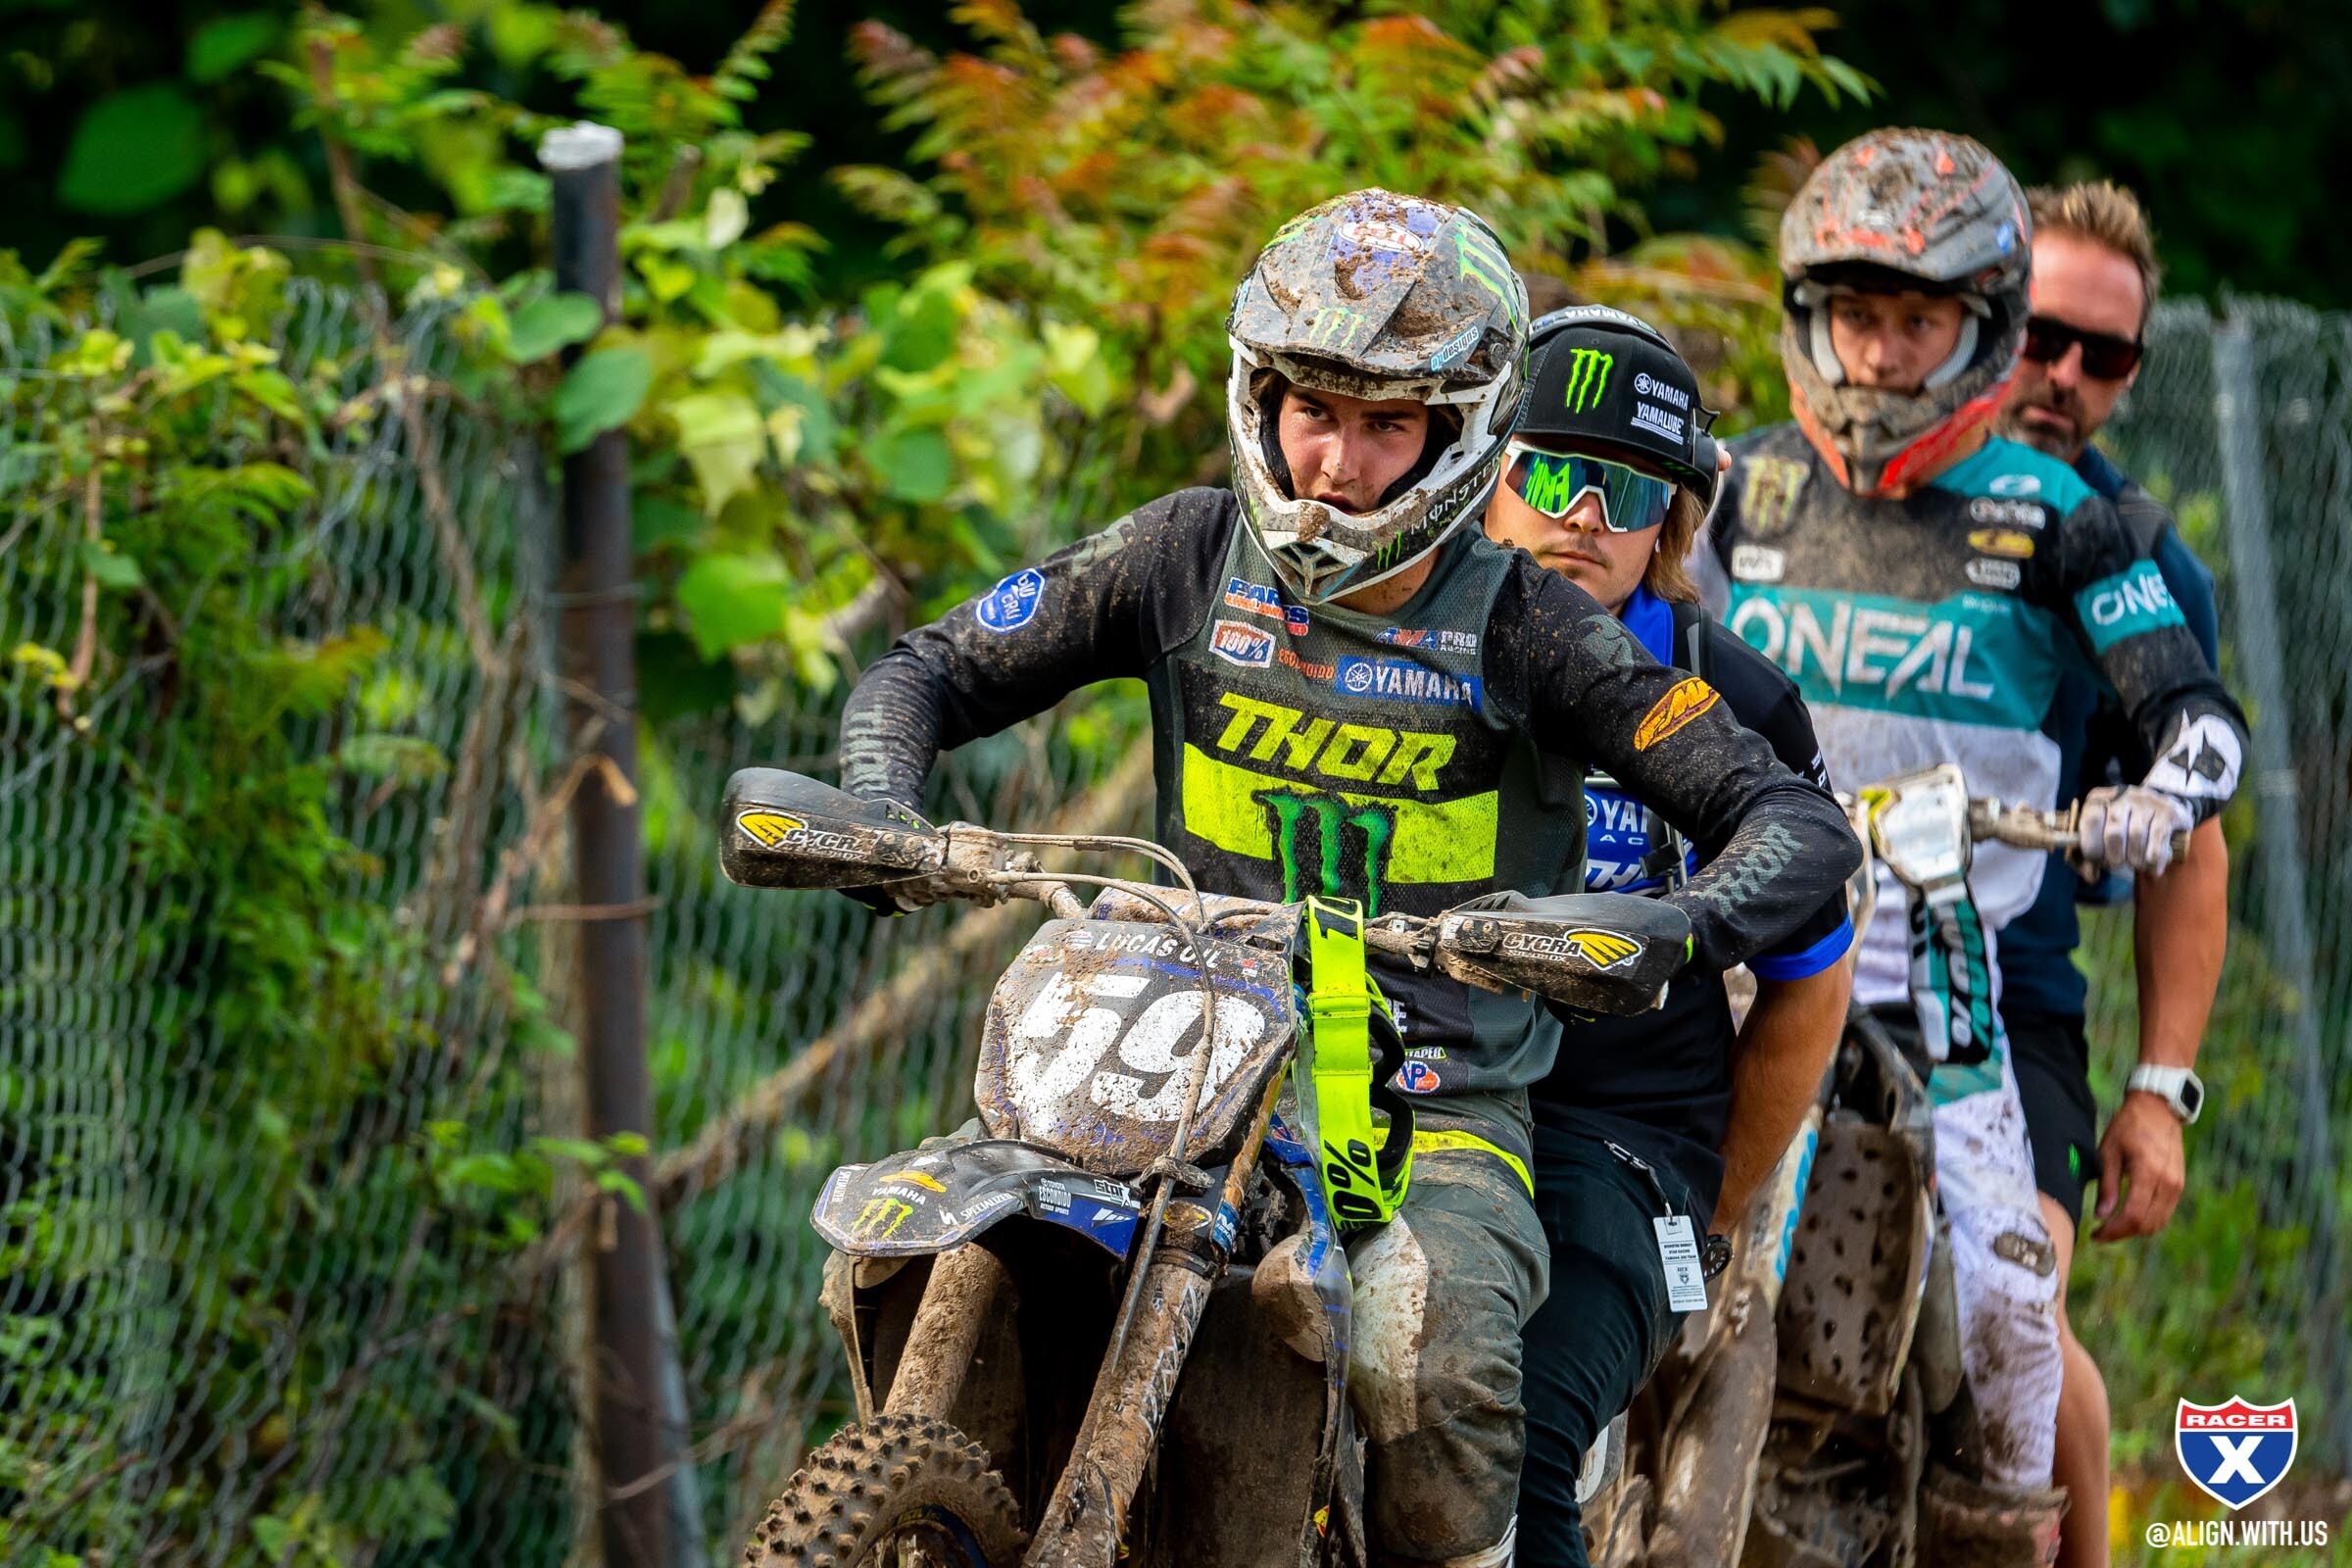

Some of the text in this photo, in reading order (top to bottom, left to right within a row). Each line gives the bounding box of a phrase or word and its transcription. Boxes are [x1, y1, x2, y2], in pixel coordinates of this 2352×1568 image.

[1651, 378, 1690, 412] YAMAHA
[1637, 401, 1685, 435] YAMALUBE
[1218, 628, 1271, 661] 100%
[1441, 630, 1477, 648] PRO
[1215, 692, 1456, 791] THOR
[1095, 932, 1179, 957] LUCAS
[1502, 932, 1584, 957] CYCRA
[1007, 972, 1265, 1123] 59
[870, 1186, 927, 1205] YAMAHA
